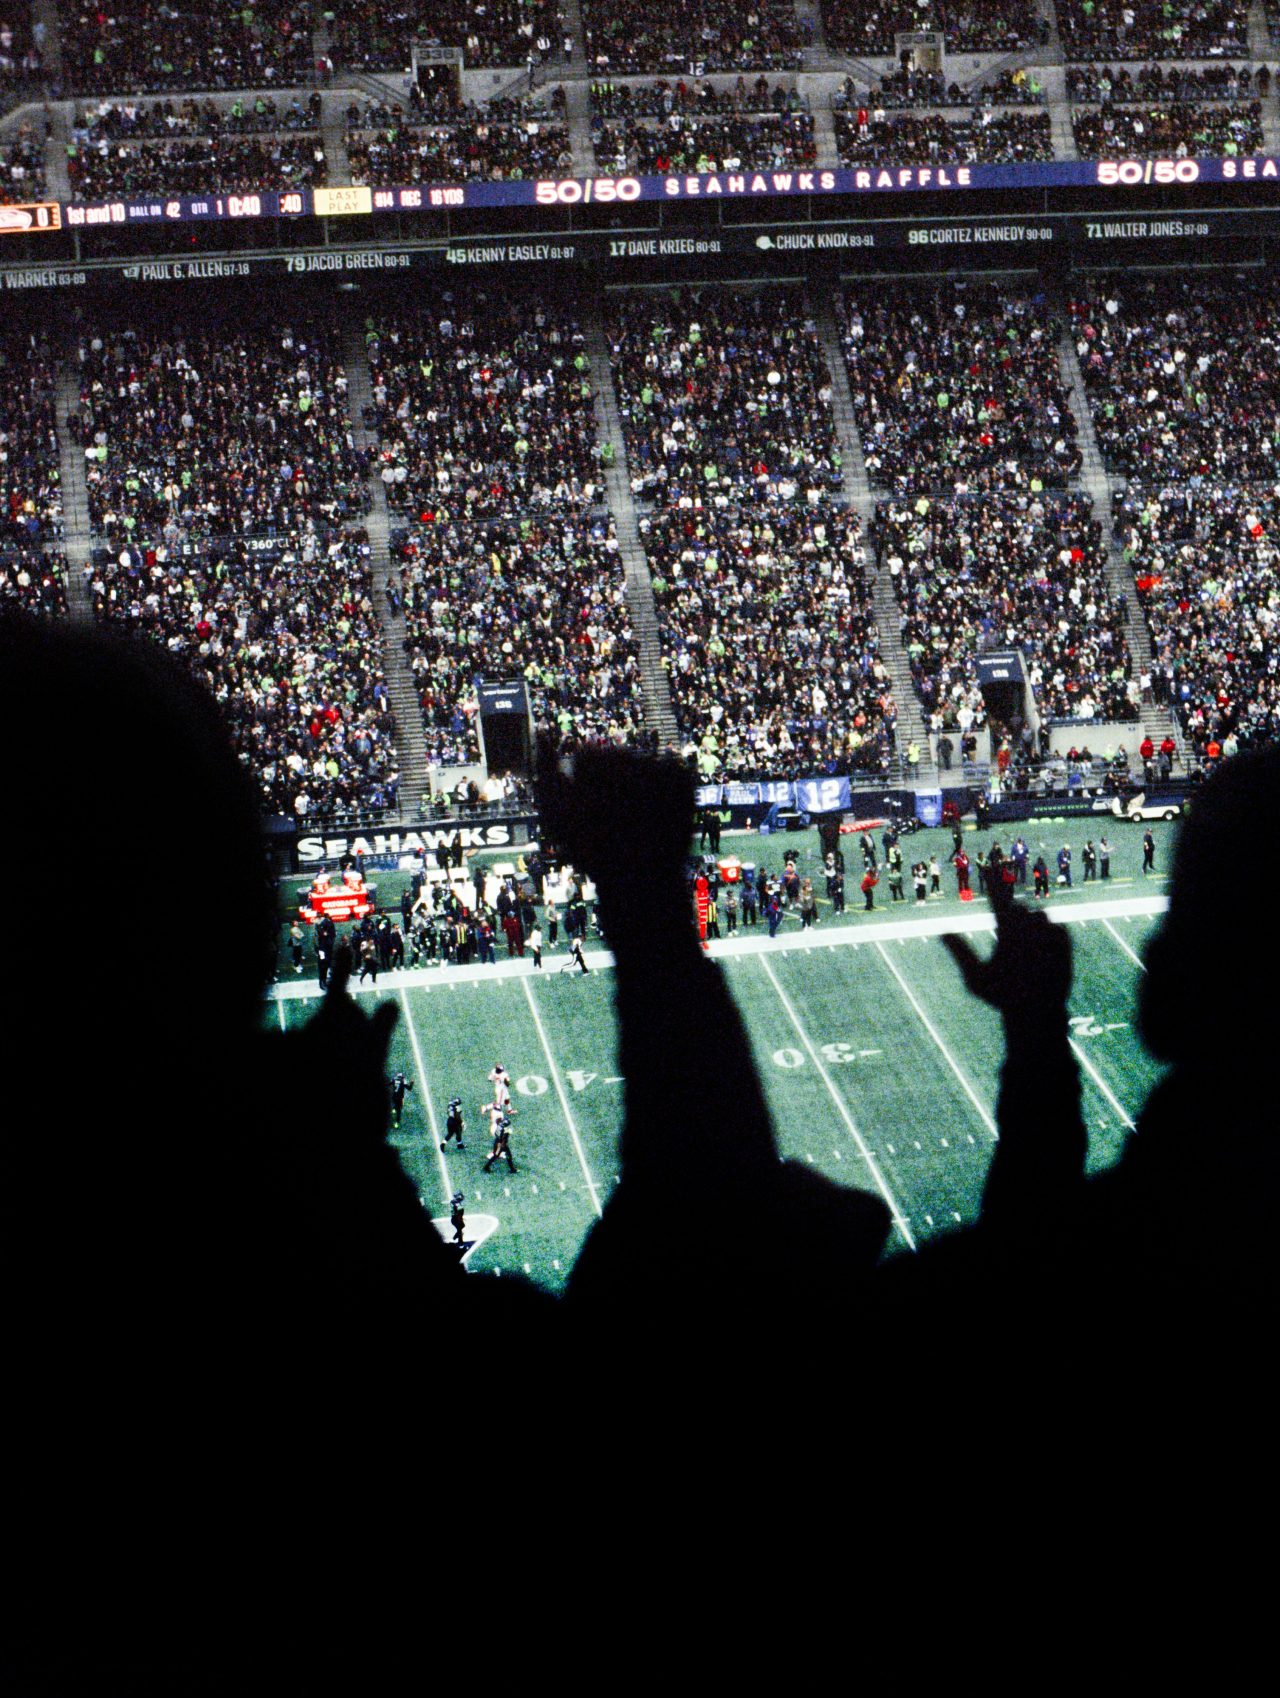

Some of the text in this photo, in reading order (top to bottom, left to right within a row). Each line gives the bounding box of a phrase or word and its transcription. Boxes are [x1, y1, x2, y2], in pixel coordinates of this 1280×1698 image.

[1098, 160, 1199, 185] 50/50
[328, 190, 358, 200] LAST
[536, 167, 971, 204] 50/50 SEAHAWKS RAFFLE
[67, 202, 126, 224] 1st and 10
[328, 202, 360, 211] PLAY
[908, 230, 929, 244] 96
[930, 228, 972, 244] CORTEZ
[974, 226, 1025, 242] KENNEDY
[1086, 224, 1103, 239] 71
[1104, 222, 1147, 238] WALTER
[1149, 222, 1183, 237] JONES
[610, 240, 626, 257] 17
[628, 239, 658, 256] DAVE
[660, 238, 695, 254] KRIEG
[776, 232, 816, 250] CHUCK
[818, 232, 848, 248] KNOX
[286, 257, 306, 272] 79
[306, 255, 342, 271] JACOB
[346, 253, 383, 270] GREEN
[446, 249, 466, 264] 45
[468, 248, 506, 263] KENNY
[508, 245, 550, 262] EASLEY
[6, 272, 57, 288] WARNER
[143, 265, 170, 280] PAUL
[174, 264, 185, 278] G.
[188, 262, 224, 278] ALLEN
[767, 782, 788, 802] 12
[806, 779, 840, 813] 12
[297, 826, 510, 861] SEAHAWKS
